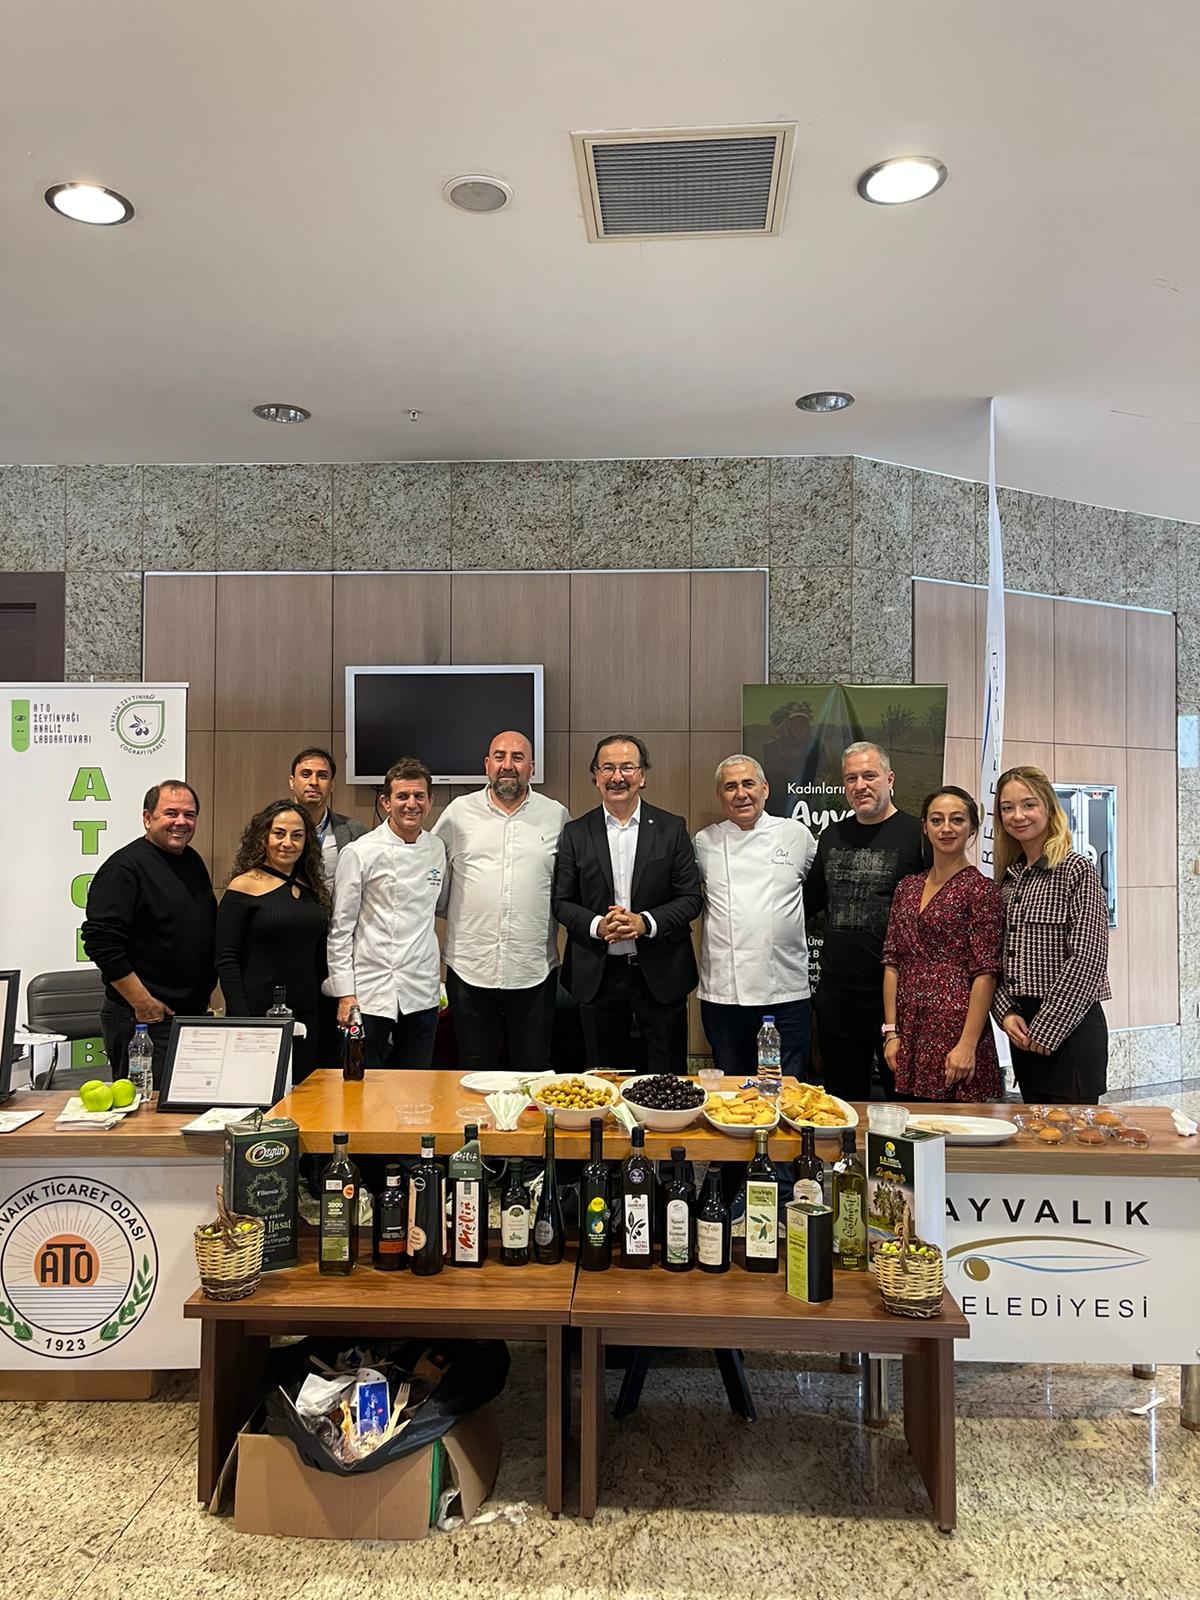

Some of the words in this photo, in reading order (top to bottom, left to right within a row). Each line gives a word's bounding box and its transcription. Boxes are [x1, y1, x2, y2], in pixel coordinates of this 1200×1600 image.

[33, 703, 51, 712] ATO
[33, 712, 79, 723] ZEYTİNYAĞI
[33, 724, 62, 733] ANALİZ
[33, 734, 92, 744] LABORATUVARI
[791, 800, 857, 836] Ayv
[252, 1143, 285, 1162] Özgün
[0, 1190, 40, 1236] VALIK
[42, 1181, 110, 1204] TİCARET
[110, 1200, 147, 1241] ODASI
[945, 1197, 1150, 1226] AYVALIK
[268, 1218, 292, 1234] Hasat
[40, 1243, 94, 1285] ATO
[961, 1294, 1148, 1319] ELEDİYESİ
[45, 1337, 86, 1352] 1923
